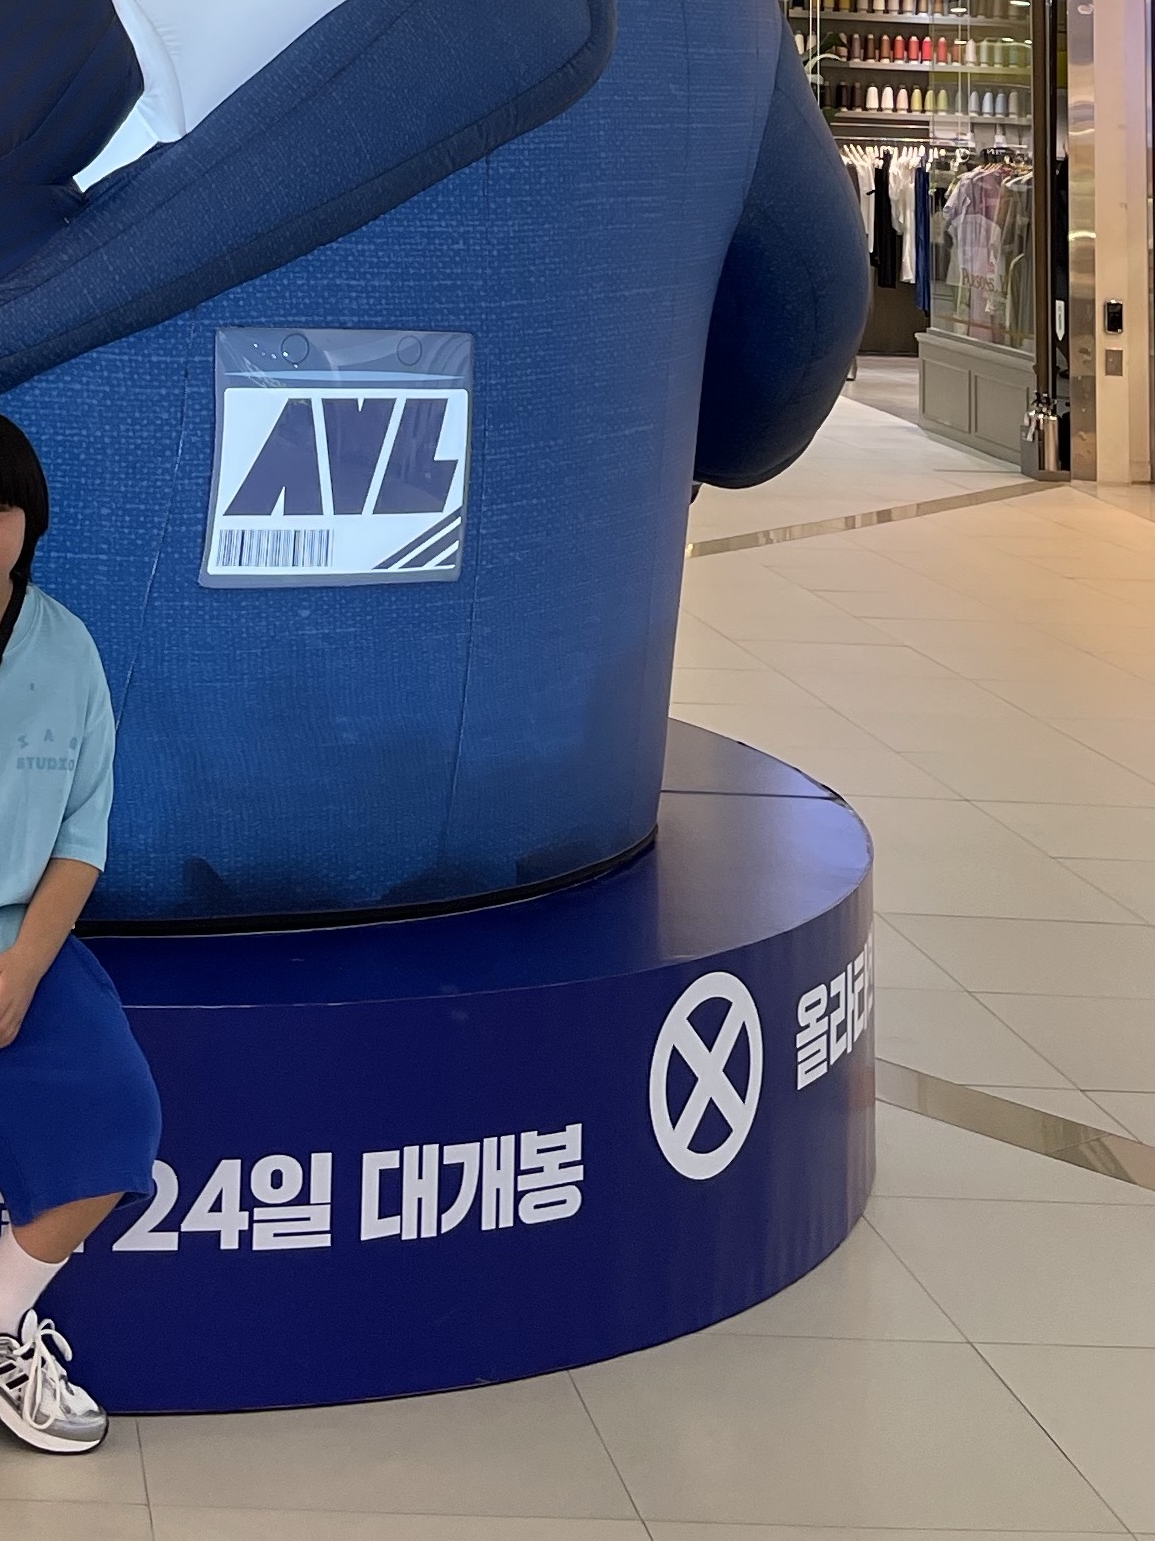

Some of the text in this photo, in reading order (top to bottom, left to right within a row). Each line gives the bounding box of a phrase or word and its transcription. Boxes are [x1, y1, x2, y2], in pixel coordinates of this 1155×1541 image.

[223, 397, 459, 517] AVL
[112, 1152, 333, 1252] 24일
[360, 1123, 585, 1242] 대개봉
